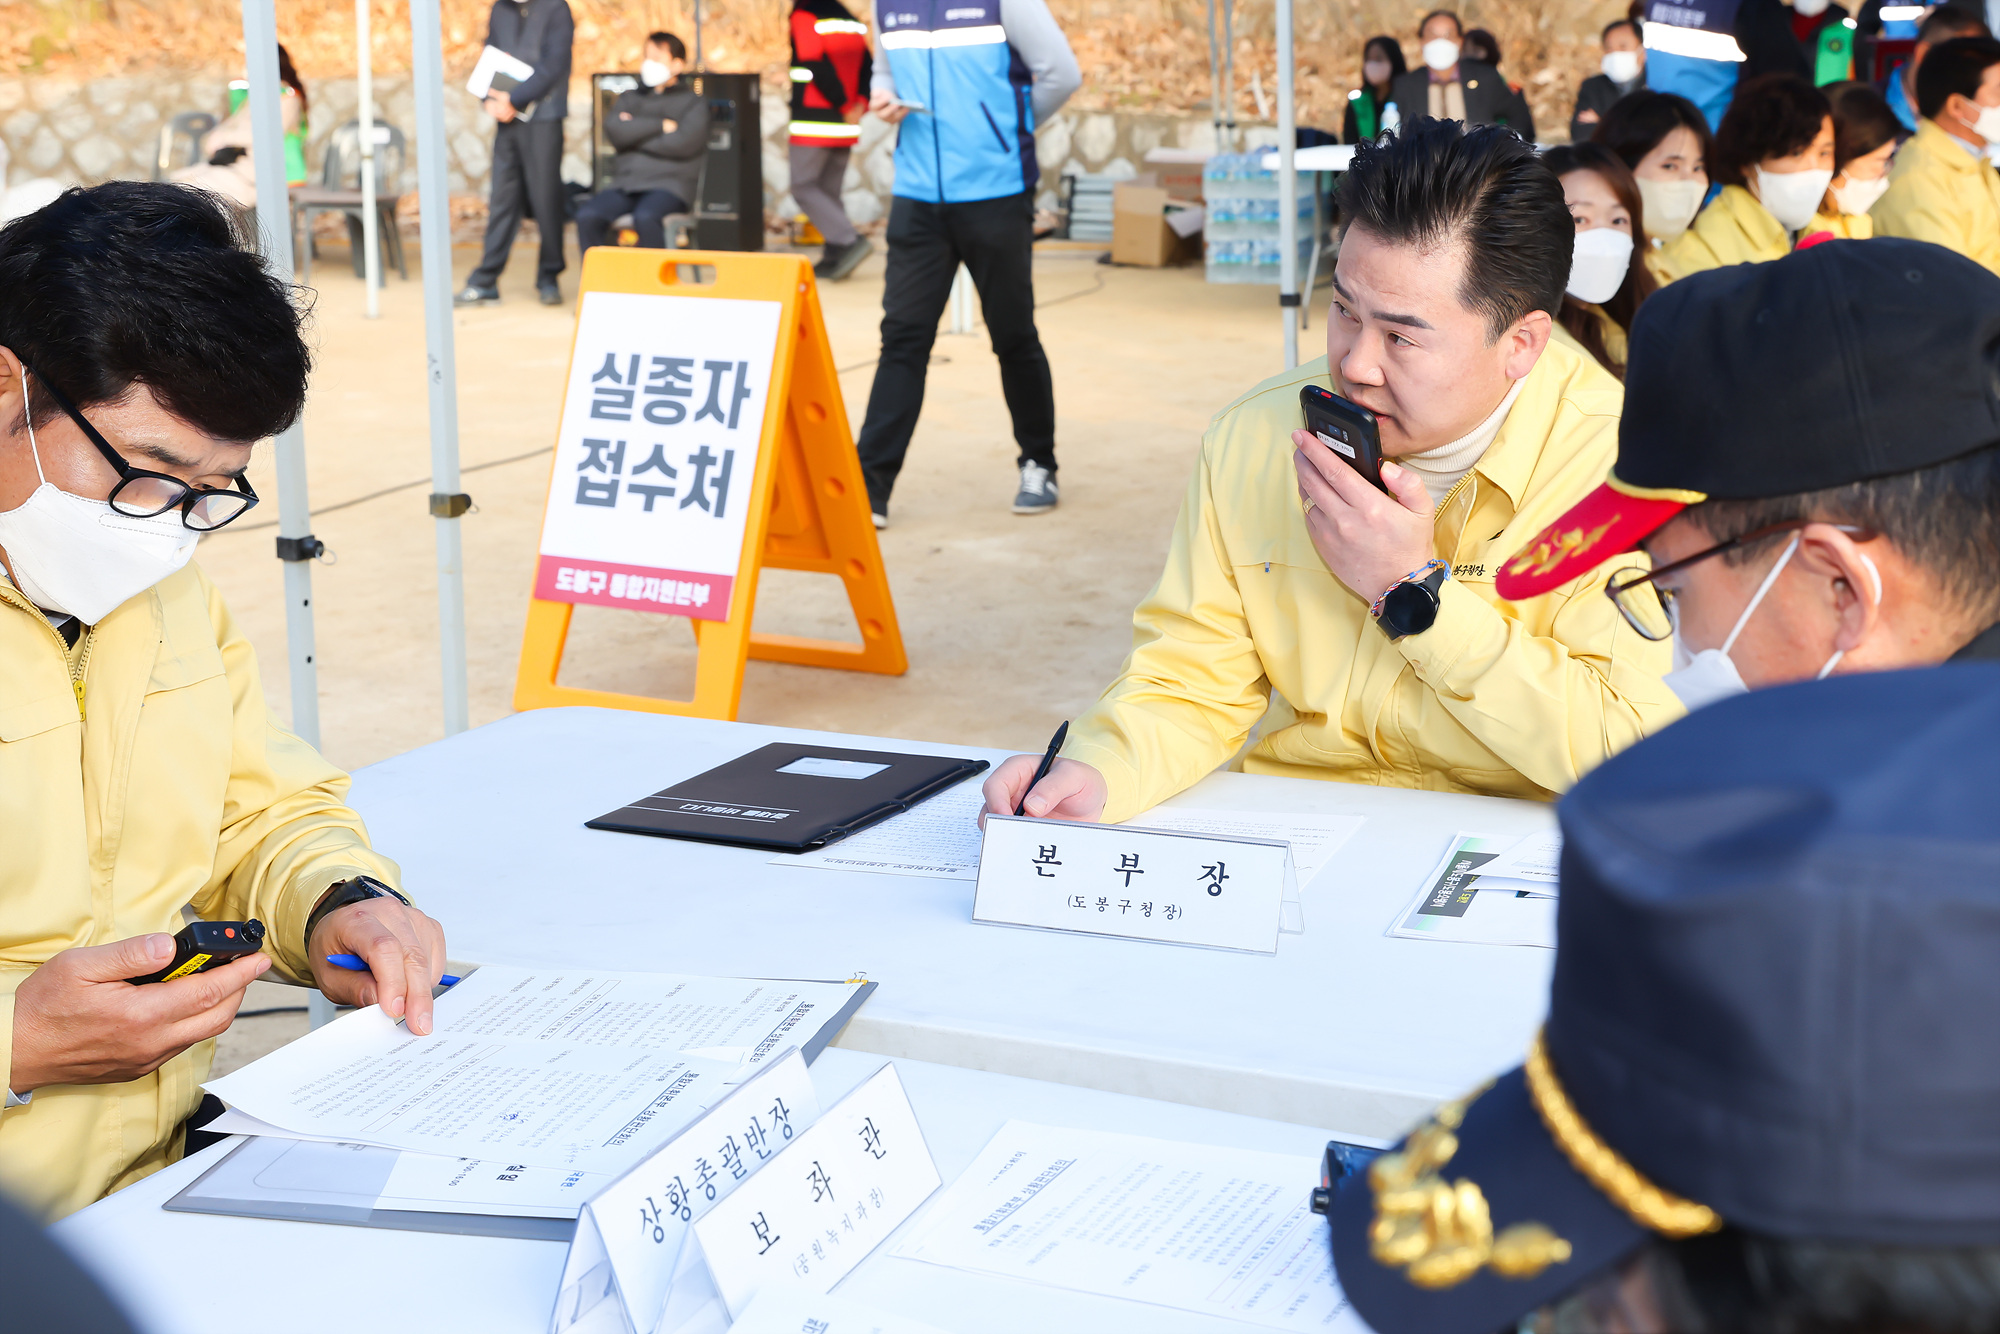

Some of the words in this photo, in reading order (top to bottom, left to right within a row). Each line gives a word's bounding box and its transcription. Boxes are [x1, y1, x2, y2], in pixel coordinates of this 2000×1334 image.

[590, 353, 751, 430] 실종자
[575, 437, 734, 518] 접수처
[555, 567, 607, 595] 도봉구
[609, 573, 711, 607] 통합지원본부
[1452, 564, 1486, 576] 봉구청장
[1067, 895, 1182, 920] (도봉구청장)
[654, 1073, 700, 1107] 통합지휘본부
[610, 1109, 658, 1146] 상황판단회의
[640, 1097, 793, 1244] 상황총괄반장
[793, 1187, 885, 1278] (공원녹지과장)
